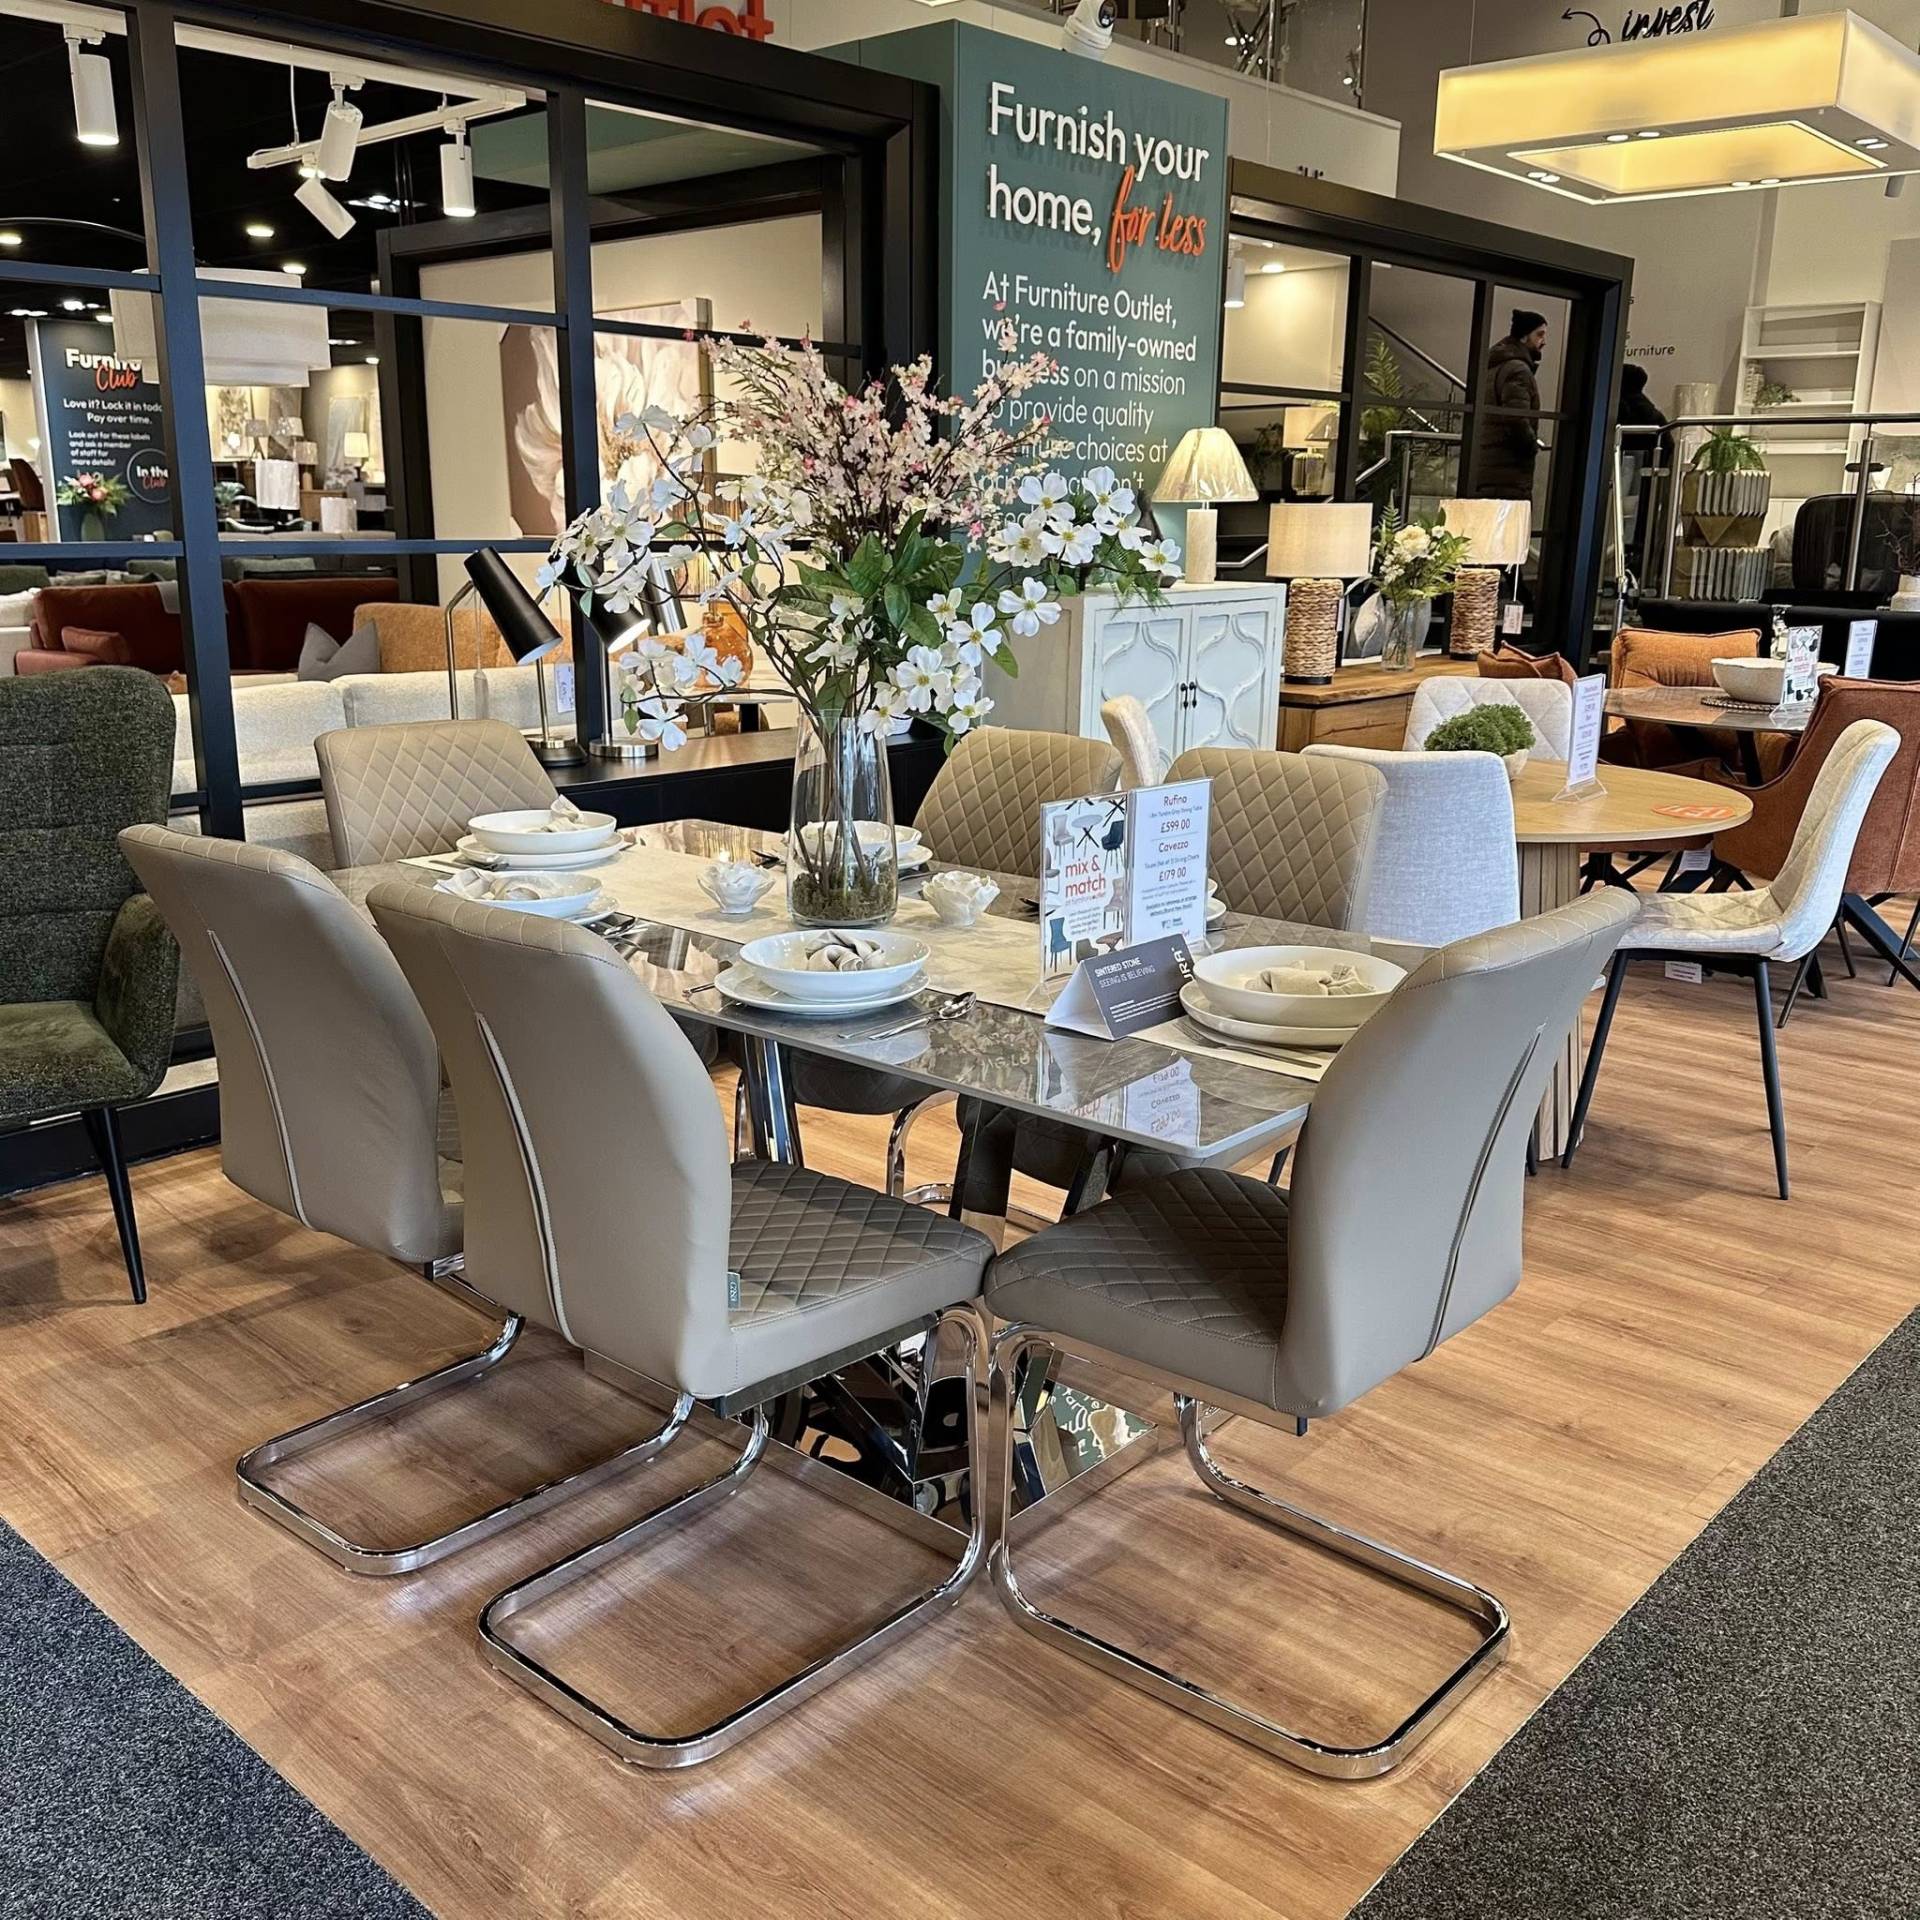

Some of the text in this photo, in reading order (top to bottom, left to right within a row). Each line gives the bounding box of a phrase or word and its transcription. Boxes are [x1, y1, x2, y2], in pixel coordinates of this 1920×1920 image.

[990, 81, 1210, 182] Furnish your
[989, 163, 1207, 273] home, for less
[982, 271, 1177, 329] At Furniture Outlet,
[1047, 326, 1061, 348] a
[1066, 320, 1197, 362] family-owned
[1626, 344, 1676, 357] urniture
[95, 364, 138, 391] Club
[1074, 366, 1099, 389] on
[1103, 370, 1116, 393] a
[1121, 365, 1186, 396] mission
[63, 398, 87, 409] Love
[88, 399, 100, 410] it?
[101, 400, 124, 410] Lock
[125, 401, 132, 411] it
[133, 401, 142, 411] in
[1010, 396, 1088, 426] provide
[1092, 400, 1154, 434] quality
[87, 412, 153, 424] Pay over time.
[68, 430, 86, 439] Look
[87, 431, 98, 439] out
[100, 431, 110, 439] for
[69, 440, 84, 448] and
[103, 441, 132, 449] member
[80, 449, 97, 457] staff
[1076, 434, 1145, 462] choices
[1150, 438, 1169, 464] at
[136, 465, 149, 478] In
[1065, 854, 1101, 878] mix &
[1065, 875, 1106, 898] match
[1094, 957, 1142, 977] SINTERED STONE
[1099, 964, 1156, 988] SEEING IS BELIEVING
